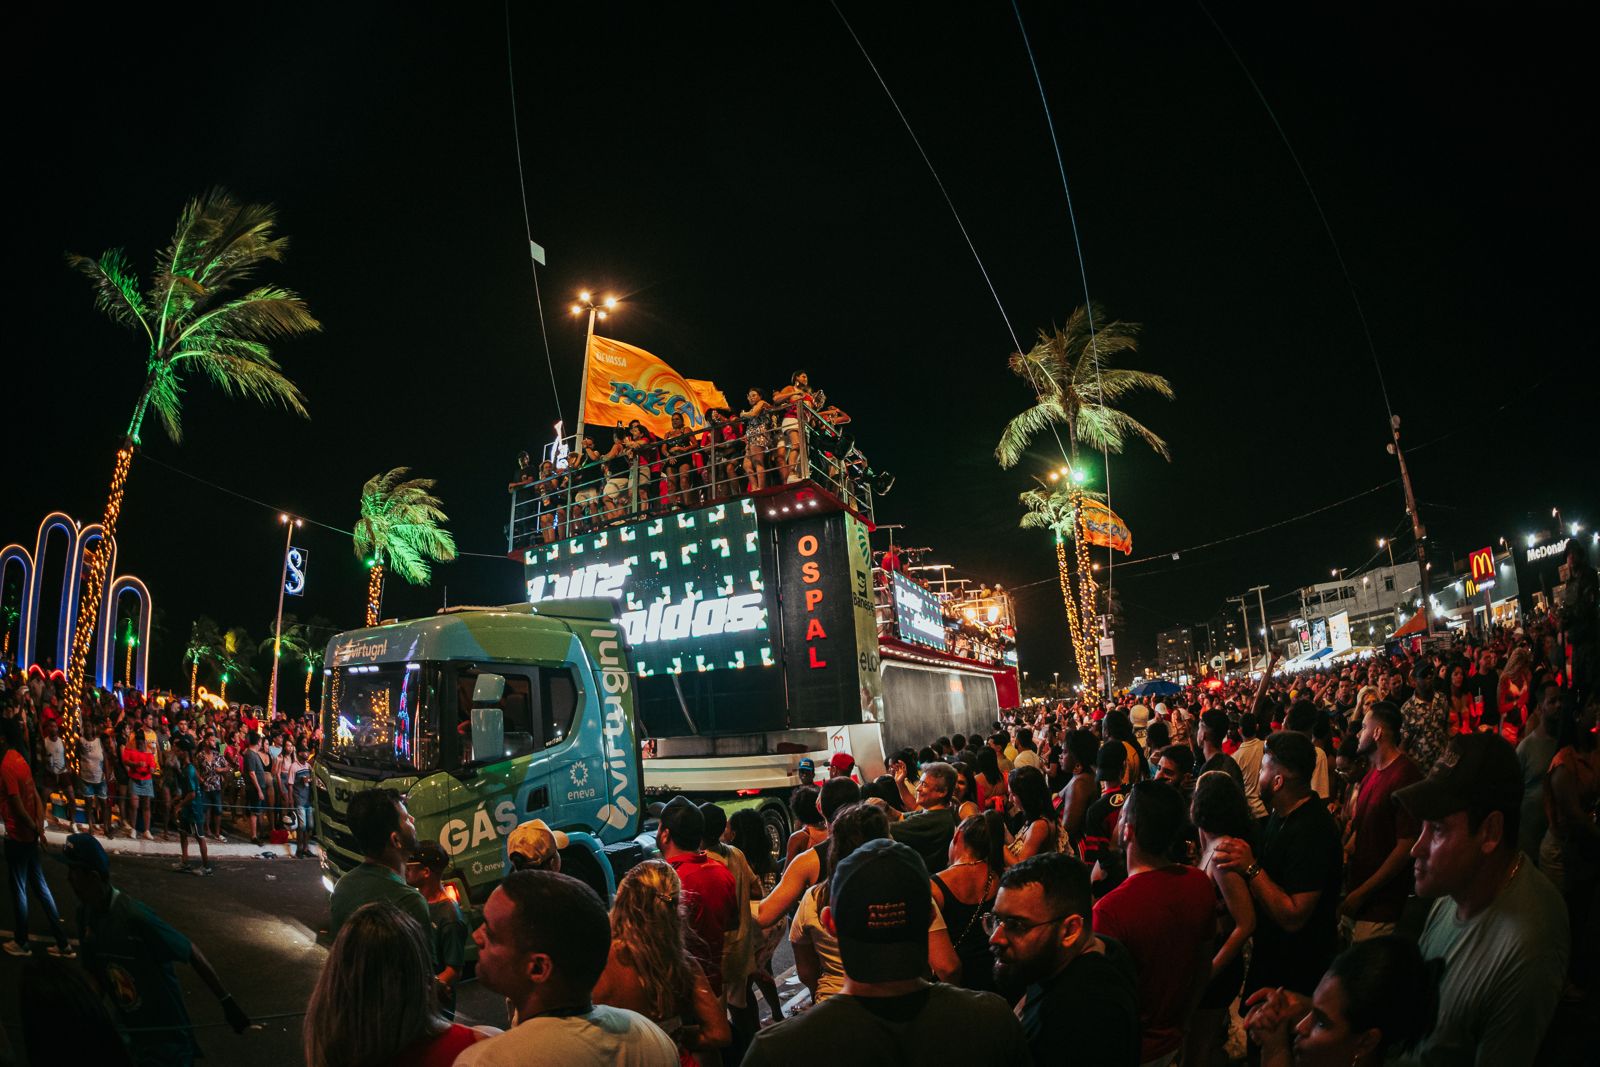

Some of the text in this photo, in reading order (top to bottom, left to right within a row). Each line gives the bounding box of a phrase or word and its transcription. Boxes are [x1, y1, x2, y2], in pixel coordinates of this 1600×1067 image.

[567, 788, 595, 800] eneva
[439, 800, 518, 856] GÁS
[484, 861, 505, 872] eneva
